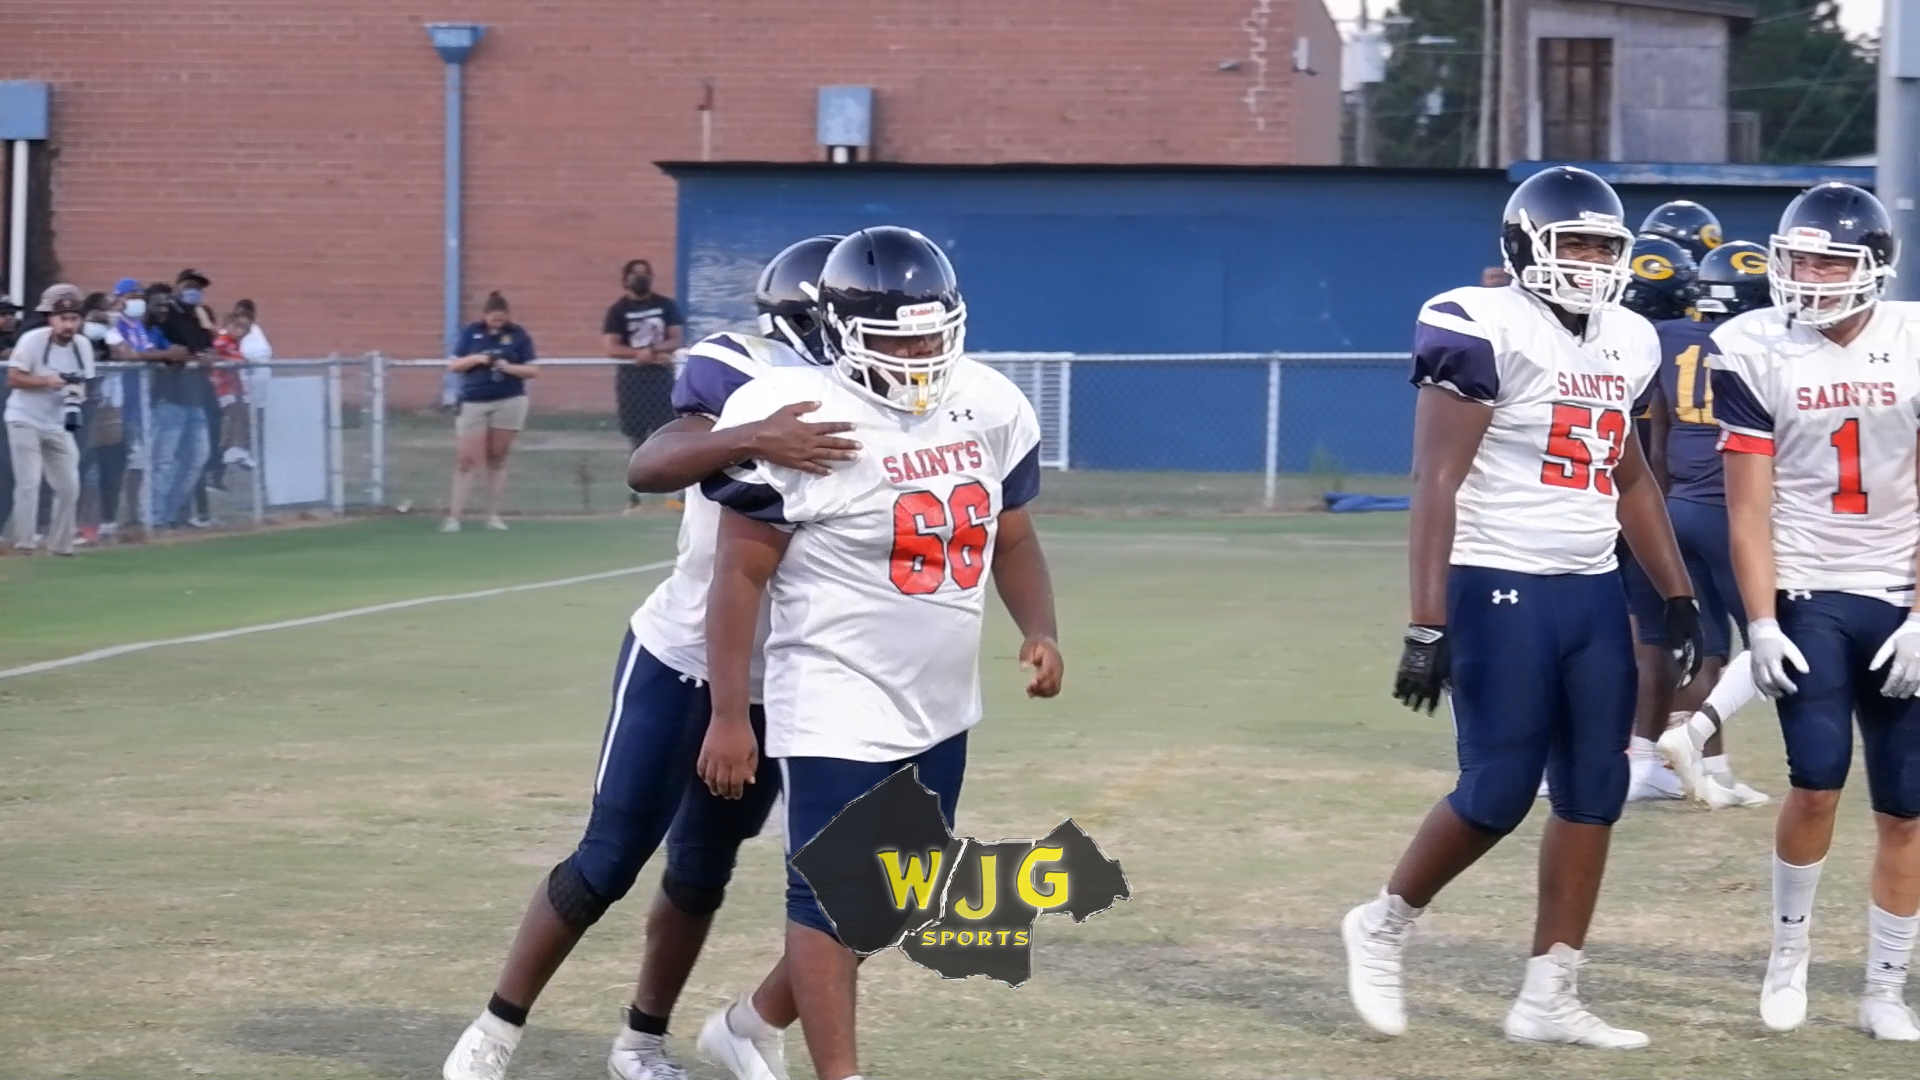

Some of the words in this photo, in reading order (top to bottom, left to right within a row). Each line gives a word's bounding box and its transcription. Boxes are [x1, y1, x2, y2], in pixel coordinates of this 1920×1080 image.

[1632, 254, 1675, 280] G
[1729, 251, 1768, 274] G
[1558, 373, 1626, 401] SAINTS
[1797, 382, 1896, 409] SAINTS
[883, 440, 982, 483] SAINTS
[1540, 403, 1625, 495] 53
[1831, 418, 1868, 514] 1
[889, 481, 990, 595] 66
